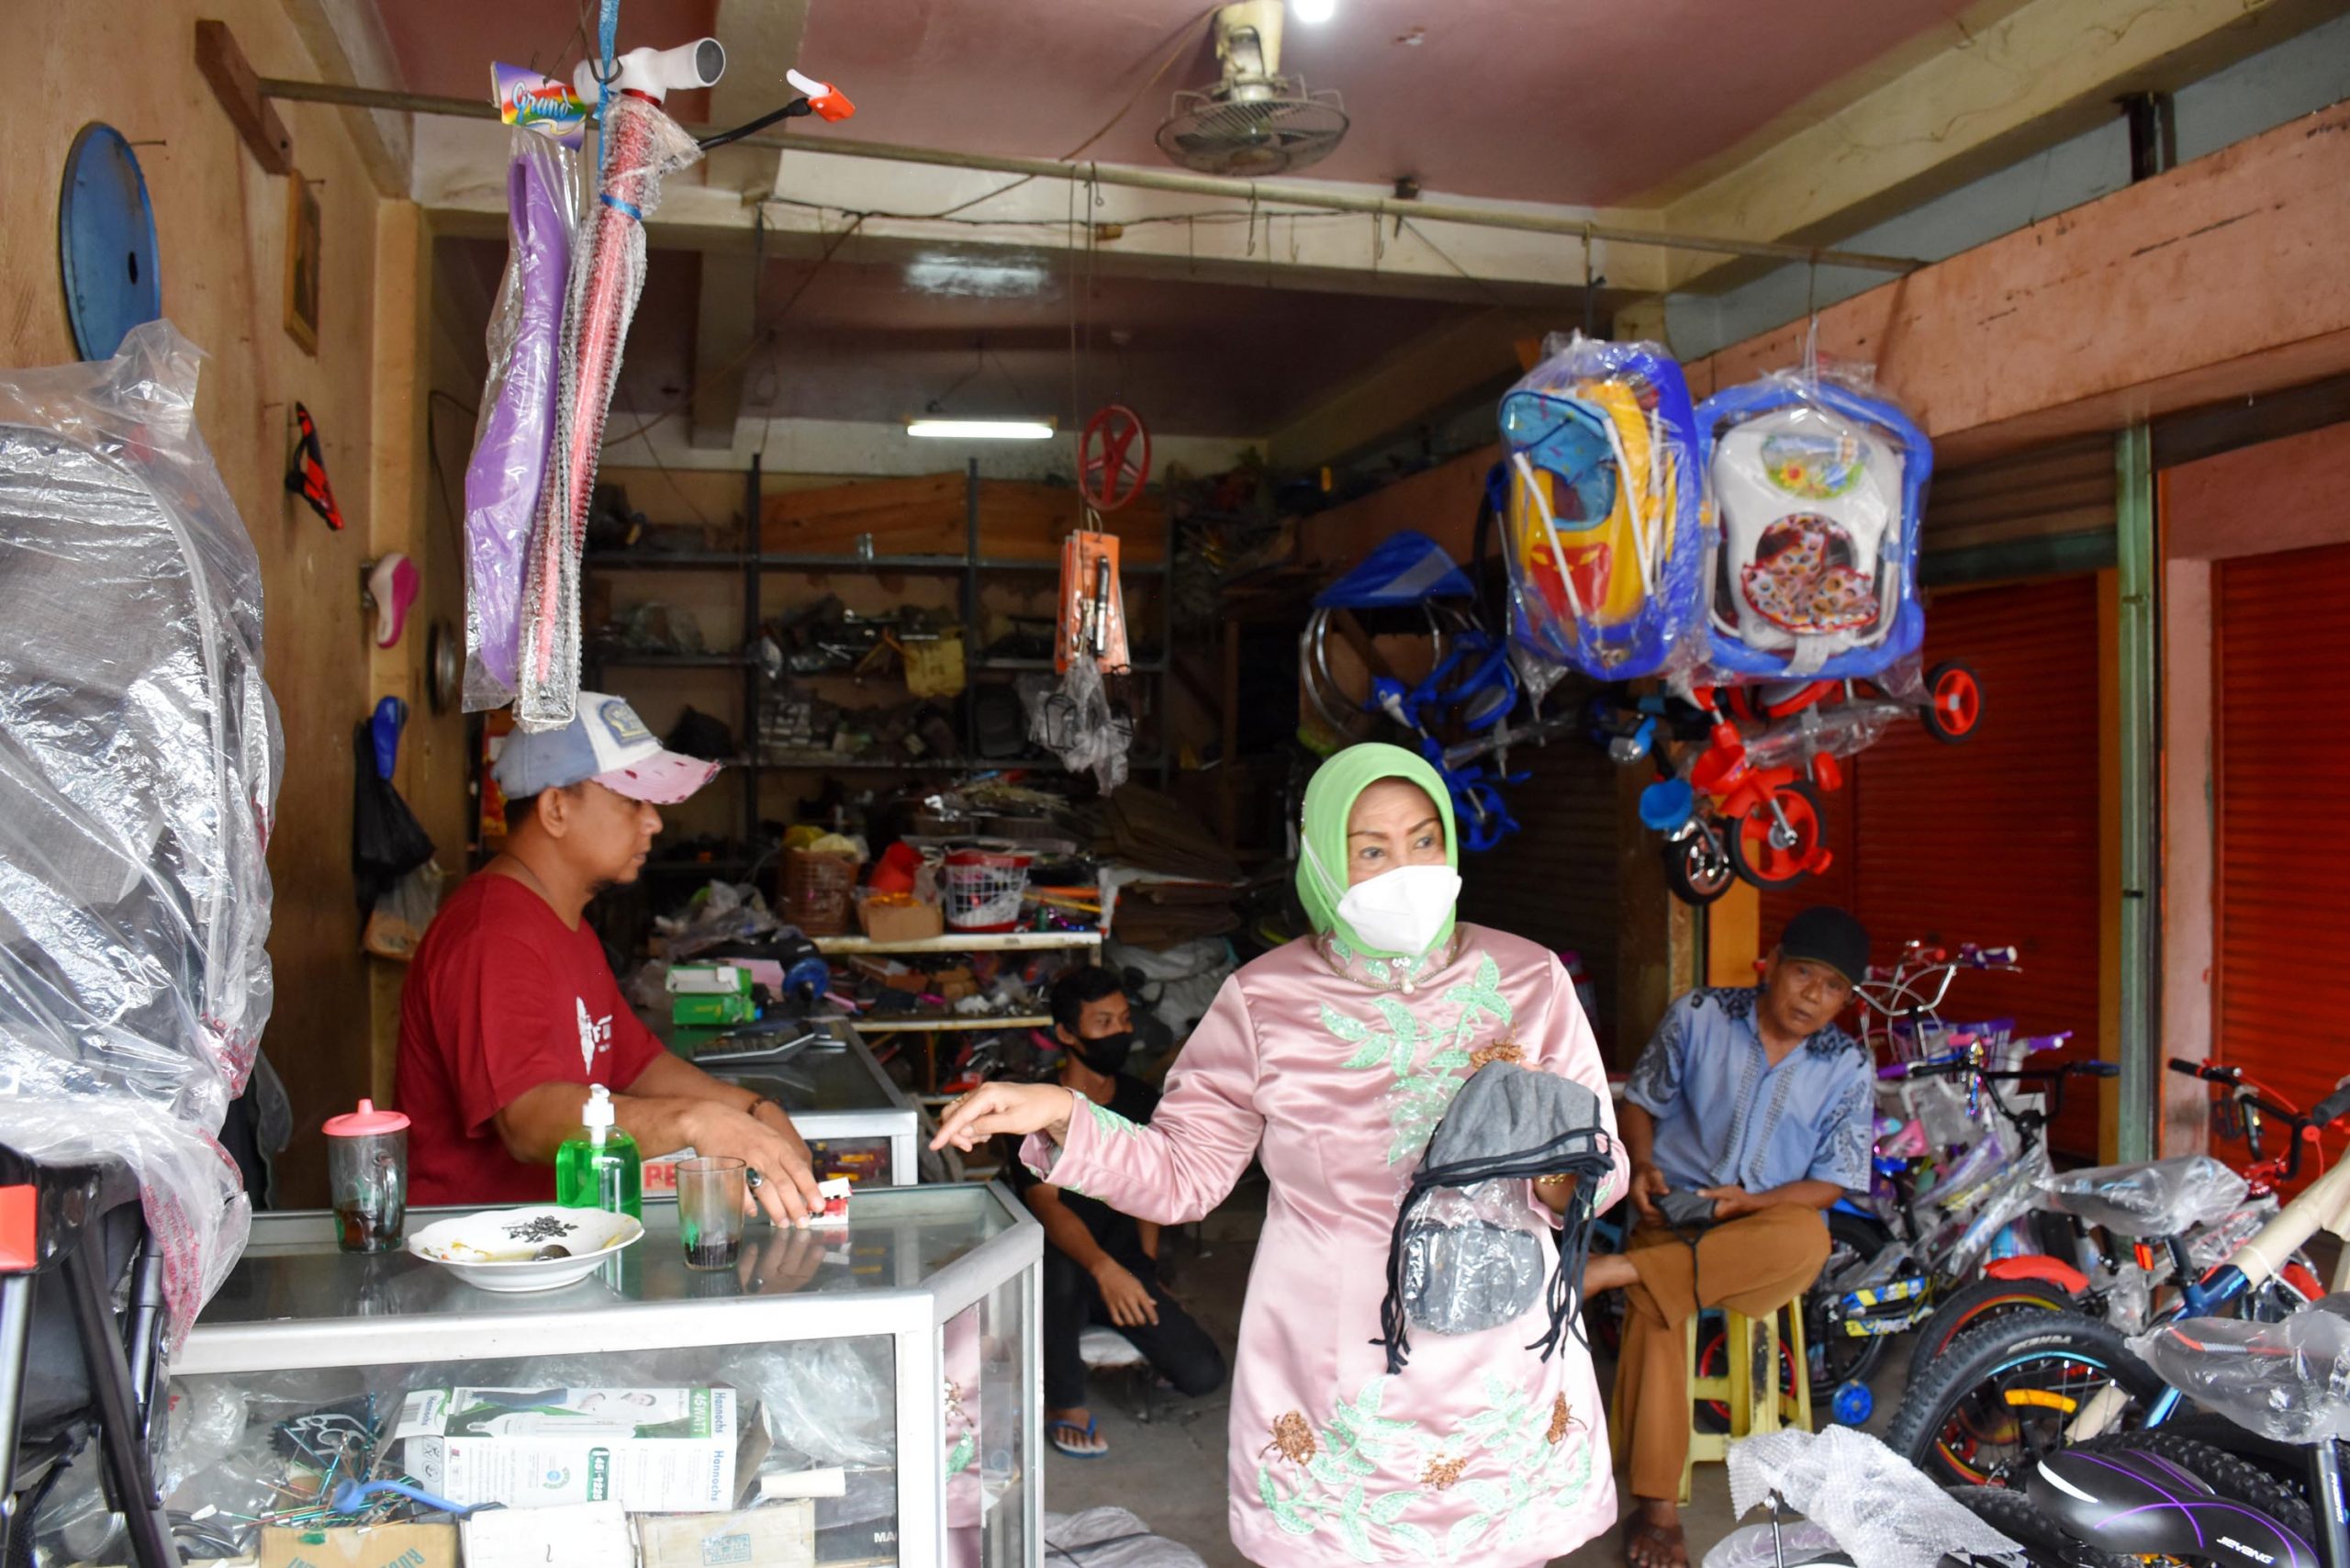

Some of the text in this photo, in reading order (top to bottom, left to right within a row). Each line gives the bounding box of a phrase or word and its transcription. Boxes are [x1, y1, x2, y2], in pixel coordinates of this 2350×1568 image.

[512, 81, 574, 125] Grand
[644, 1163, 676, 1188] PE
[693, 1391, 706, 1434] 45WATT
[714, 1392, 727, 1433] Hannochs
[710, 1450, 724, 1502] Hannochs
[873, 1530, 898, 1543] MA
